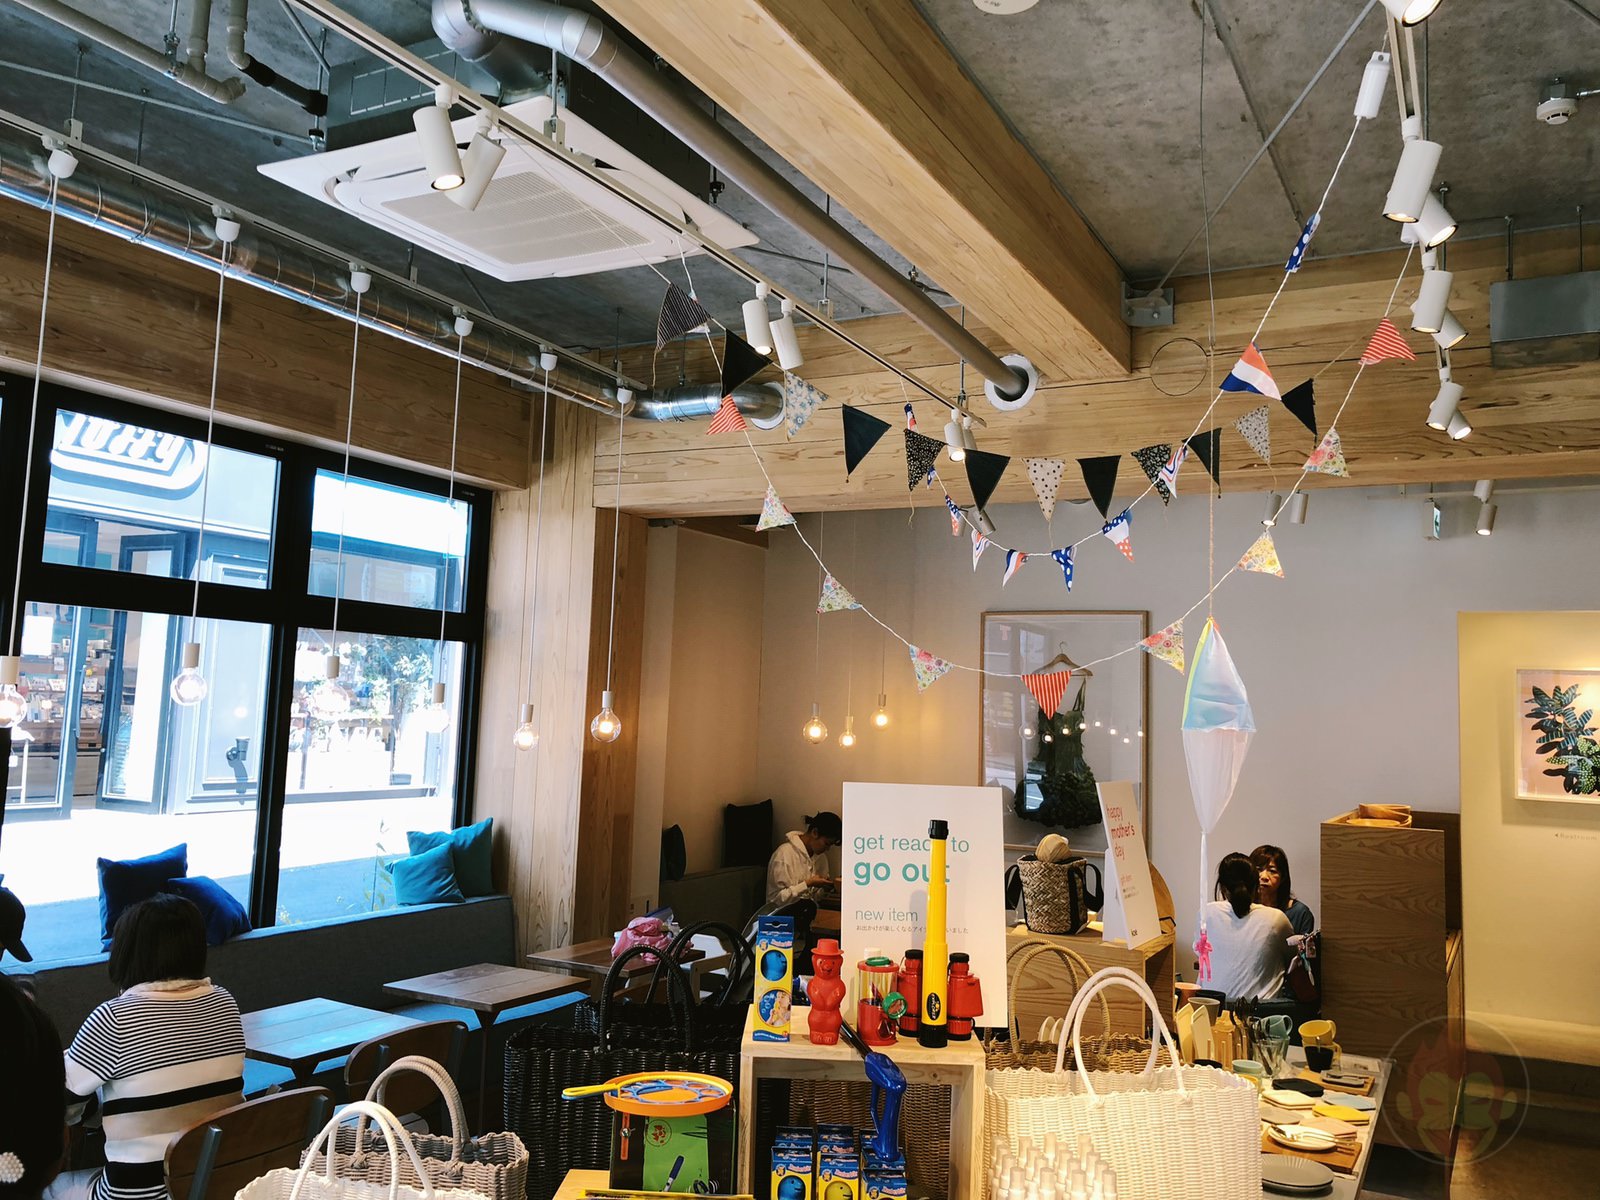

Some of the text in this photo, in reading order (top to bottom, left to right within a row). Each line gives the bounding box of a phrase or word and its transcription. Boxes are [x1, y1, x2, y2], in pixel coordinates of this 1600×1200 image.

[1105, 804, 1124, 822] happy
[1110, 821, 1136, 840] mother's
[853, 834, 885, 855] get
[952, 837, 970, 853] to
[1114, 842, 1126, 861] day
[853, 861, 891, 886] go
[855, 908, 919, 922] new item
